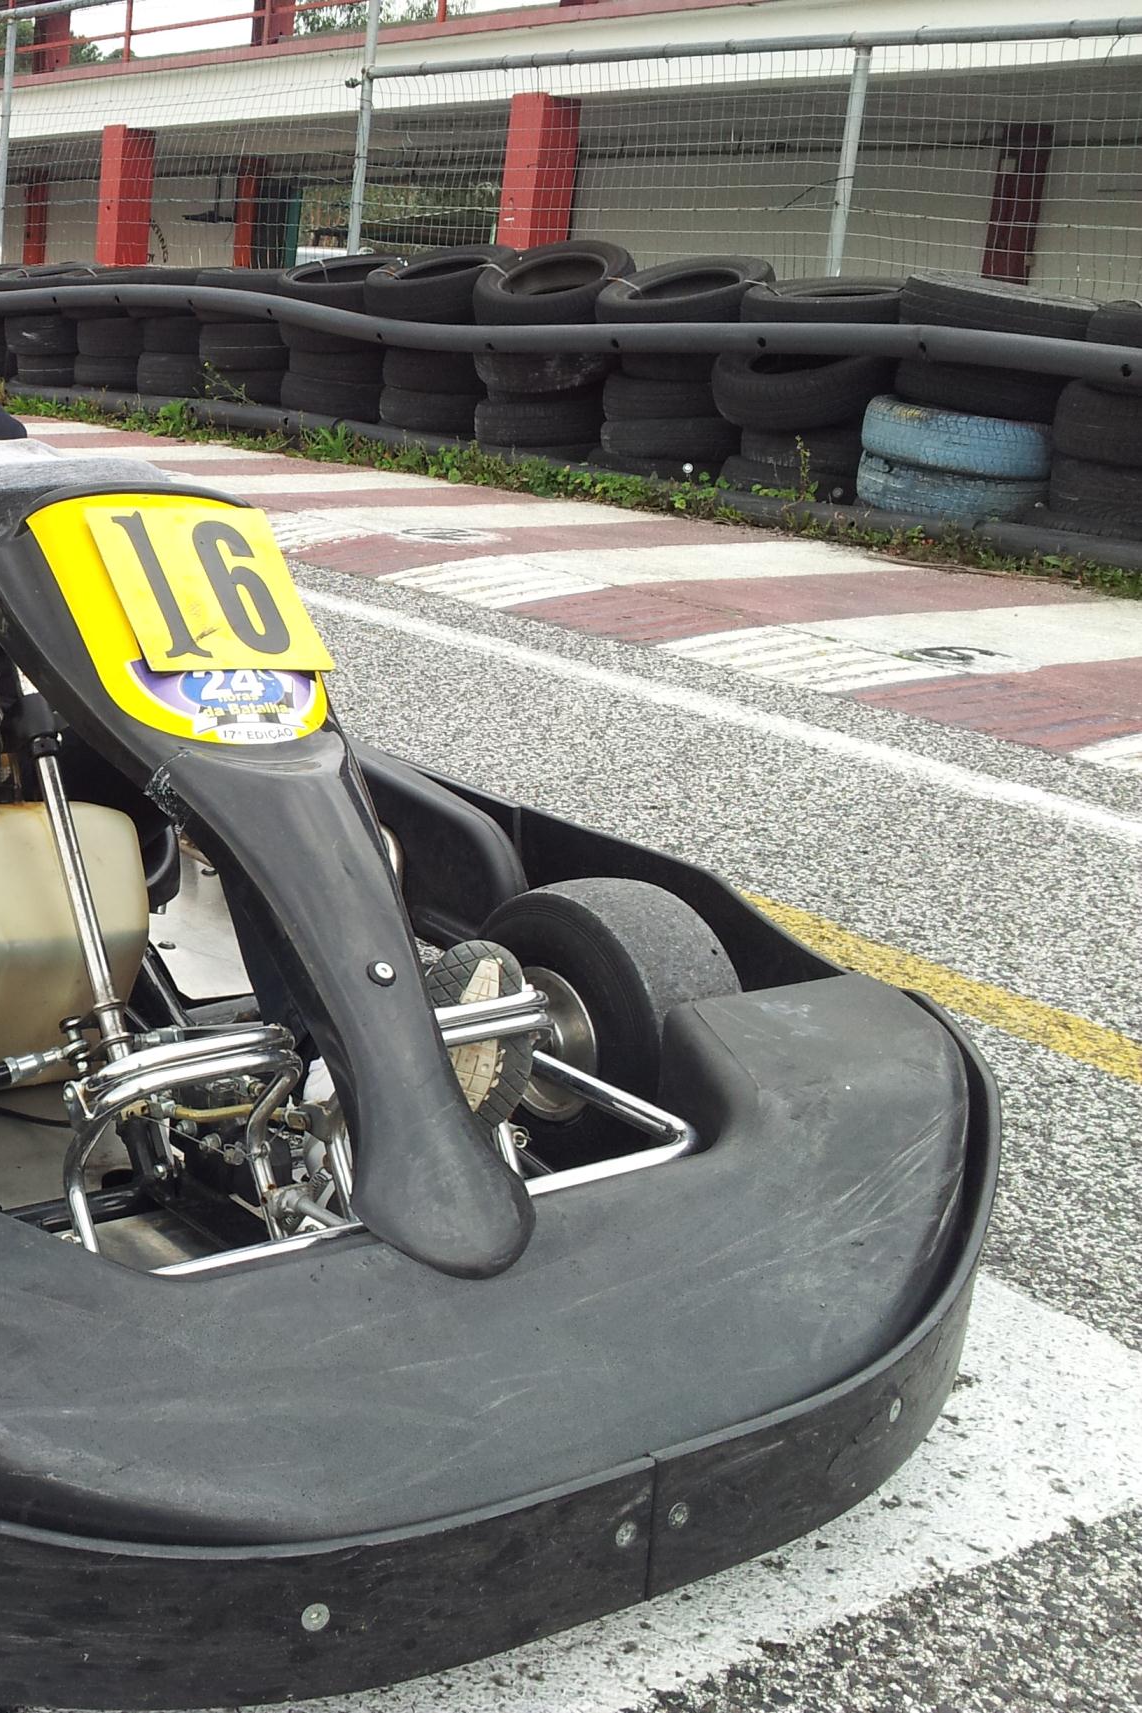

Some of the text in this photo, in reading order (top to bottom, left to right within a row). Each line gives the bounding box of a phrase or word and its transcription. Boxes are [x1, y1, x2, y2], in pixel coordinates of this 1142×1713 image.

[111, 511, 290, 658] 16
[192, 669, 265, 701] 24
[202, 702, 289, 718] da Batalha
